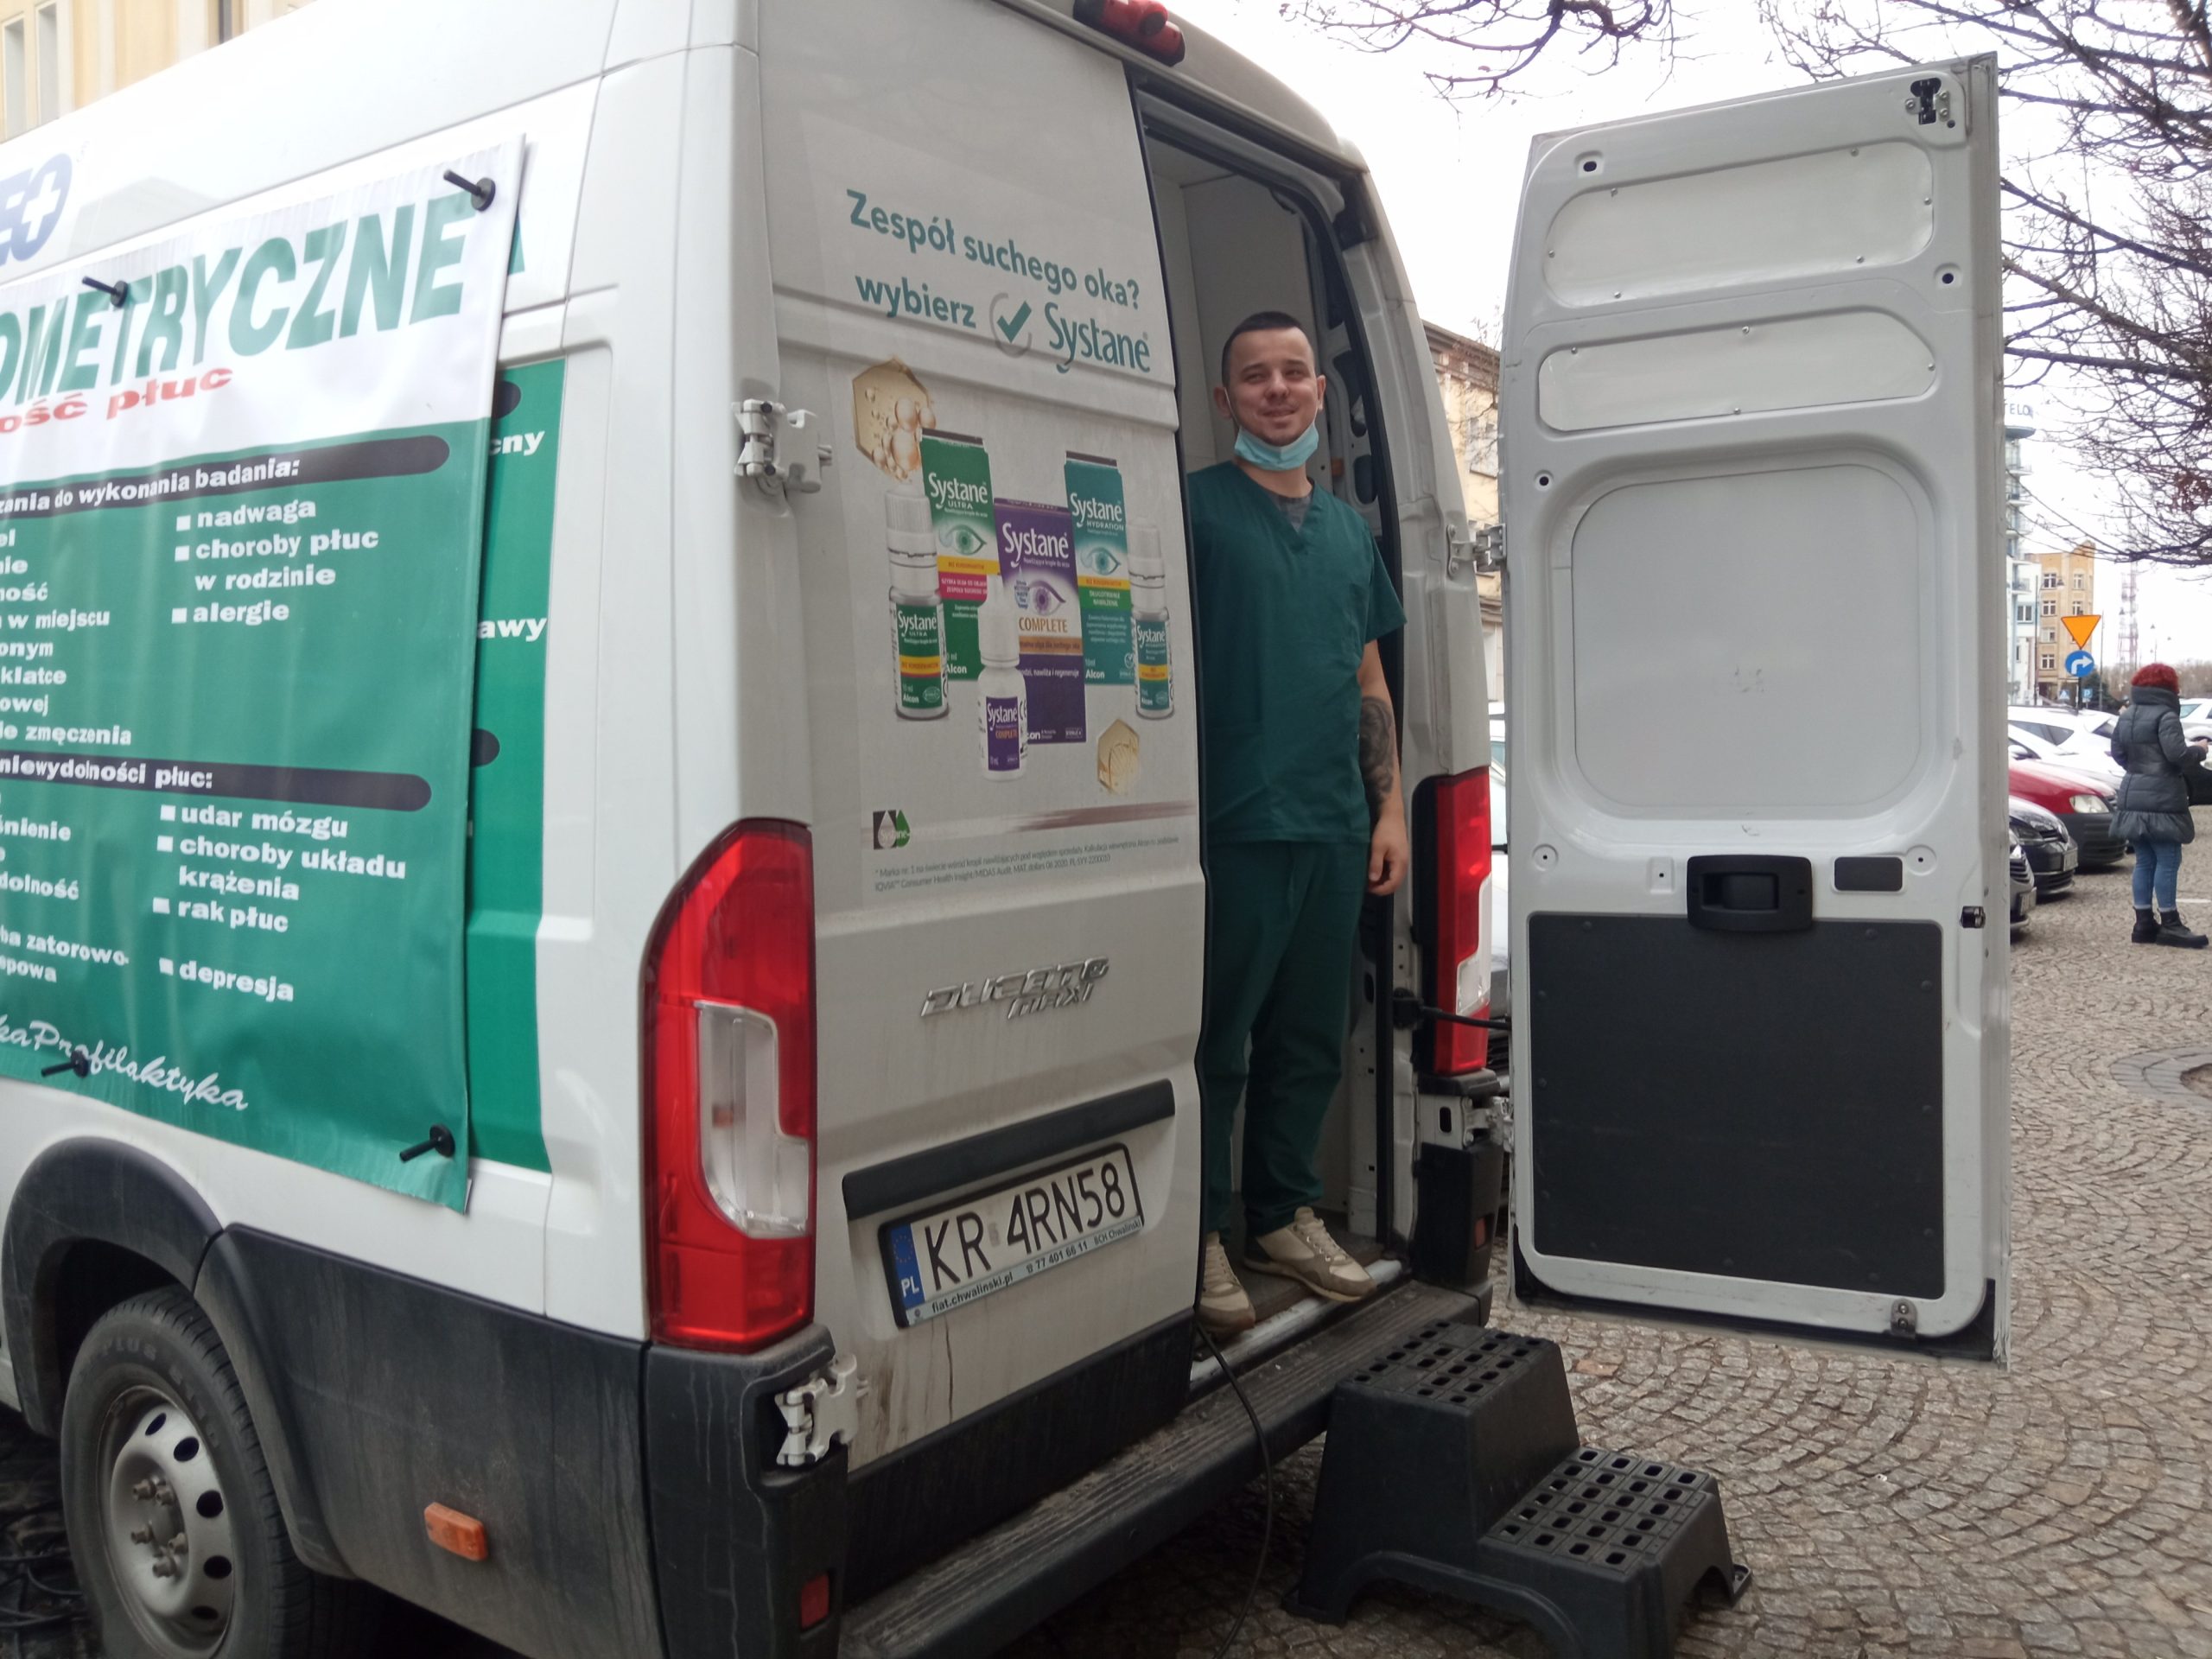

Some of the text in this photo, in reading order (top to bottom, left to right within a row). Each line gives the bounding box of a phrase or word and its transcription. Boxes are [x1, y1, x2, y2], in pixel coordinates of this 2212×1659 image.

[846, 188, 1140, 310] Zespół suchego oka?
[855, 275, 1151, 374] wybierz Systane
[106, 368, 233, 421] płuc
[54, 489, 73, 508] do
[79, 473, 190, 506] wykonania
[195, 459, 300, 488] badania:
[928, 472, 988, 510] Systane
[197, 499, 316, 528] nadwaga
[947, 499, 973, 510] ULTRA
[1071, 492, 1122, 528] Systane
[196, 528, 379, 558] choroby płuc
[1002, 522, 1069, 568] Systane
[194, 563, 336, 591] w rodzinie
[8, 608, 110, 632] w miejscu
[193, 600, 289, 626] alergie
[899, 610, 937, 637] Systane
[1019, 617, 1068, 632] COMPLETE
[477, 617, 548, 642] awy
[1137, 625, 1166, 649] Systane
[1, 666, 67, 684] klatce
[946, 664, 967, 674] Alcon
[1085, 669, 1105, 679] Alcon
[903, 694, 919, 703] Alcon
[987, 702, 1018, 731] Systane
[25, 725, 132, 746] zmęczenia
[155, 766, 213, 788] płuc:
[181, 804, 347, 840] udar mózgu
[180, 835, 406, 879] choroby układu
[179, 865, 300, 900] krążenia
[177, 900, 289, 932] rak płuc
[179, 960, 294, 1002] depresja
[920, 956, 1109, 1017] DUCATO
[1007, 982, 1093, 1020] MAXI
[900, 1162, 1125, 1298] PL KR 4RN58
[931, 1271, 1014, 1313] fiat.chwalinski.pl
[1036, 1257, 1046, 1269] 77
[1049, 1250, 1064, 1263] 401
[1065, 1245, 1077, 1257] 66
[1079, 1240, 1088, 1251] 11
